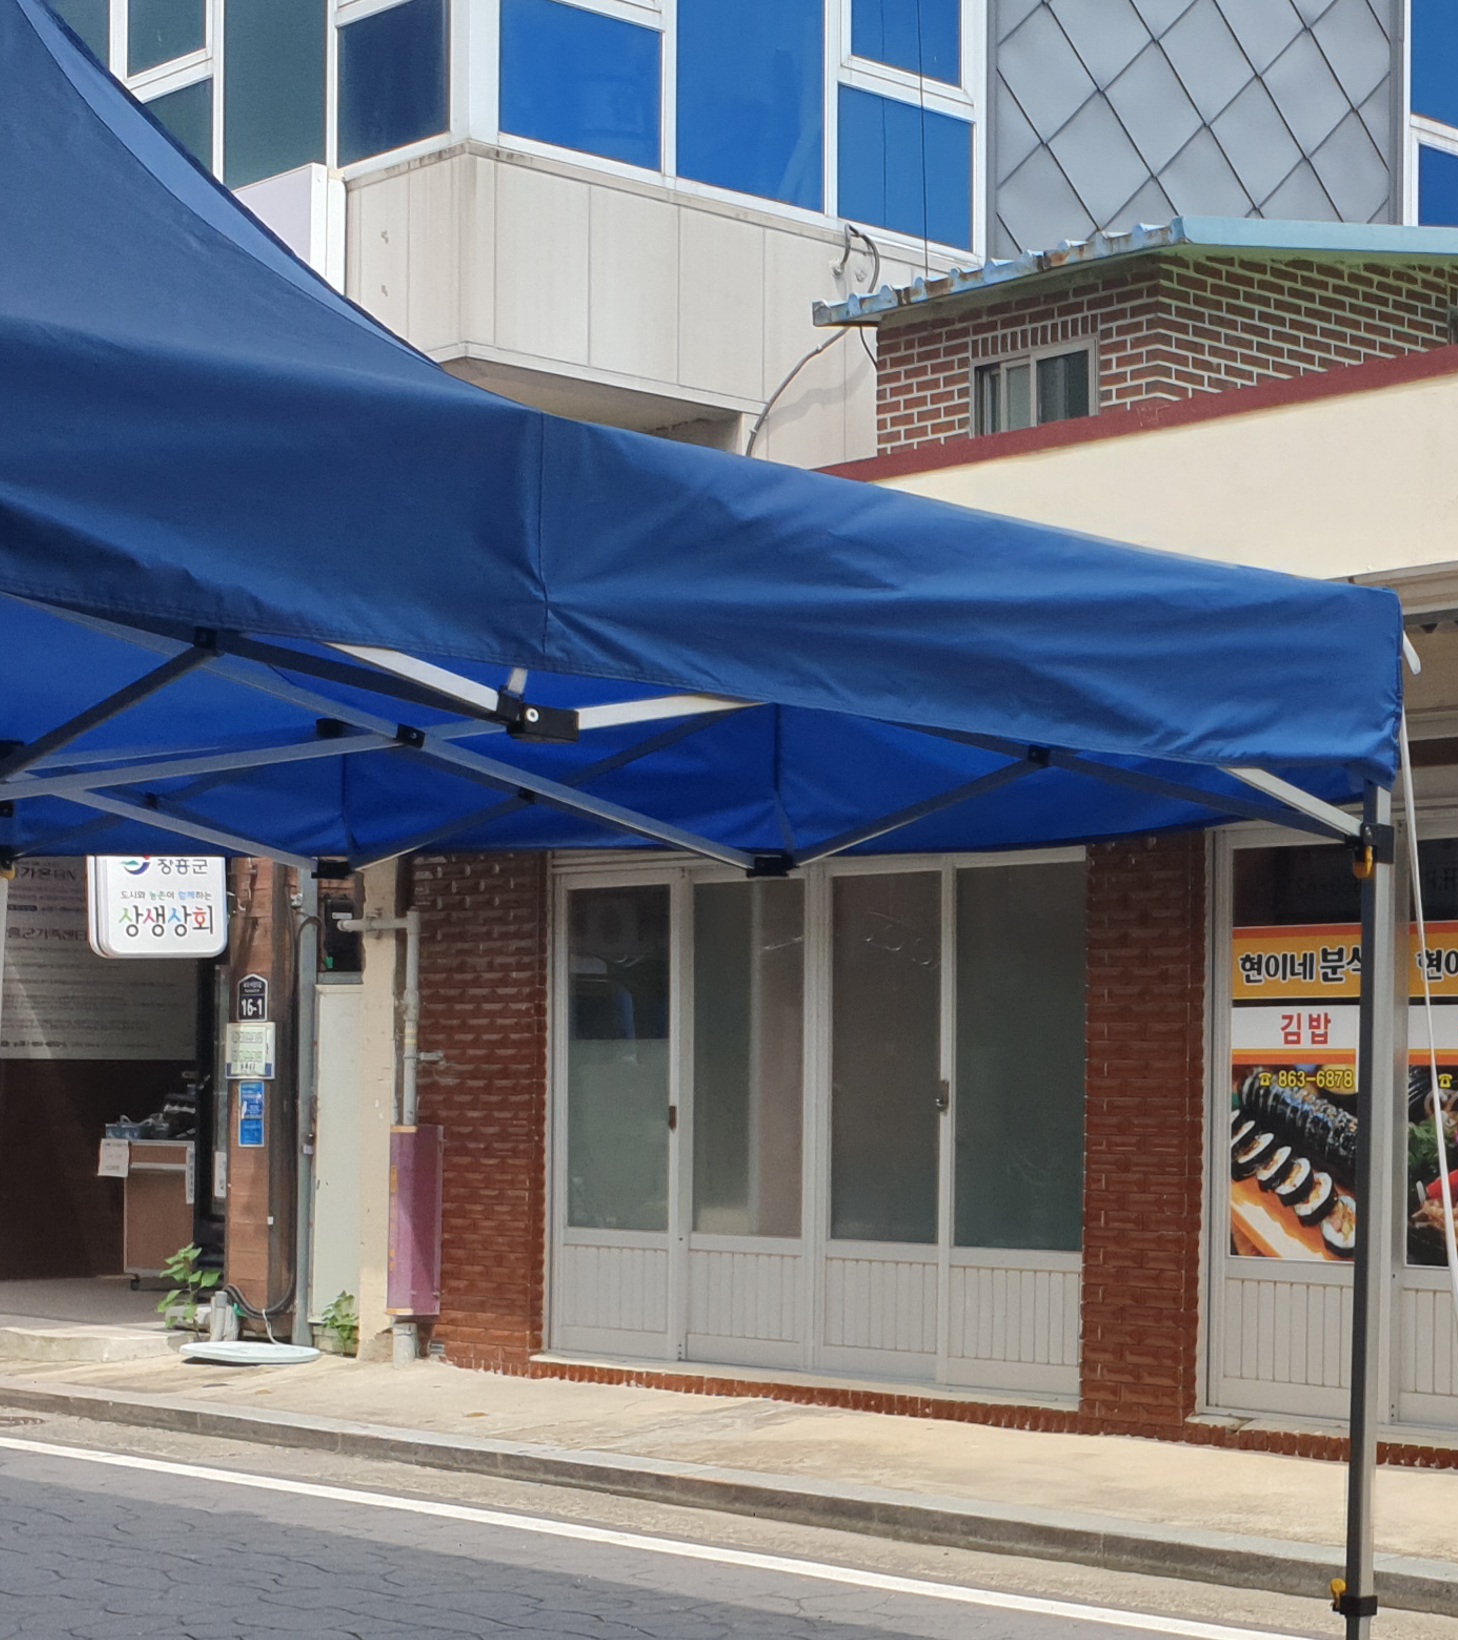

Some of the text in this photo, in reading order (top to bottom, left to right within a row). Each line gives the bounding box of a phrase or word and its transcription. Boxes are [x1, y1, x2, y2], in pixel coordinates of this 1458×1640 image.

[156, 858, 209, 876] 장흥군
[120, 890, 146, 901] 도시와
[118, 904, 214, 938] 상생상회
[1240, 952, 1316, 984] 현이네
[241, 998, 263, 1017] 16-1
[1280, 1012, 1332, 1046] 김밥
[1277, 1070, 1354, 1089] 863-6878
